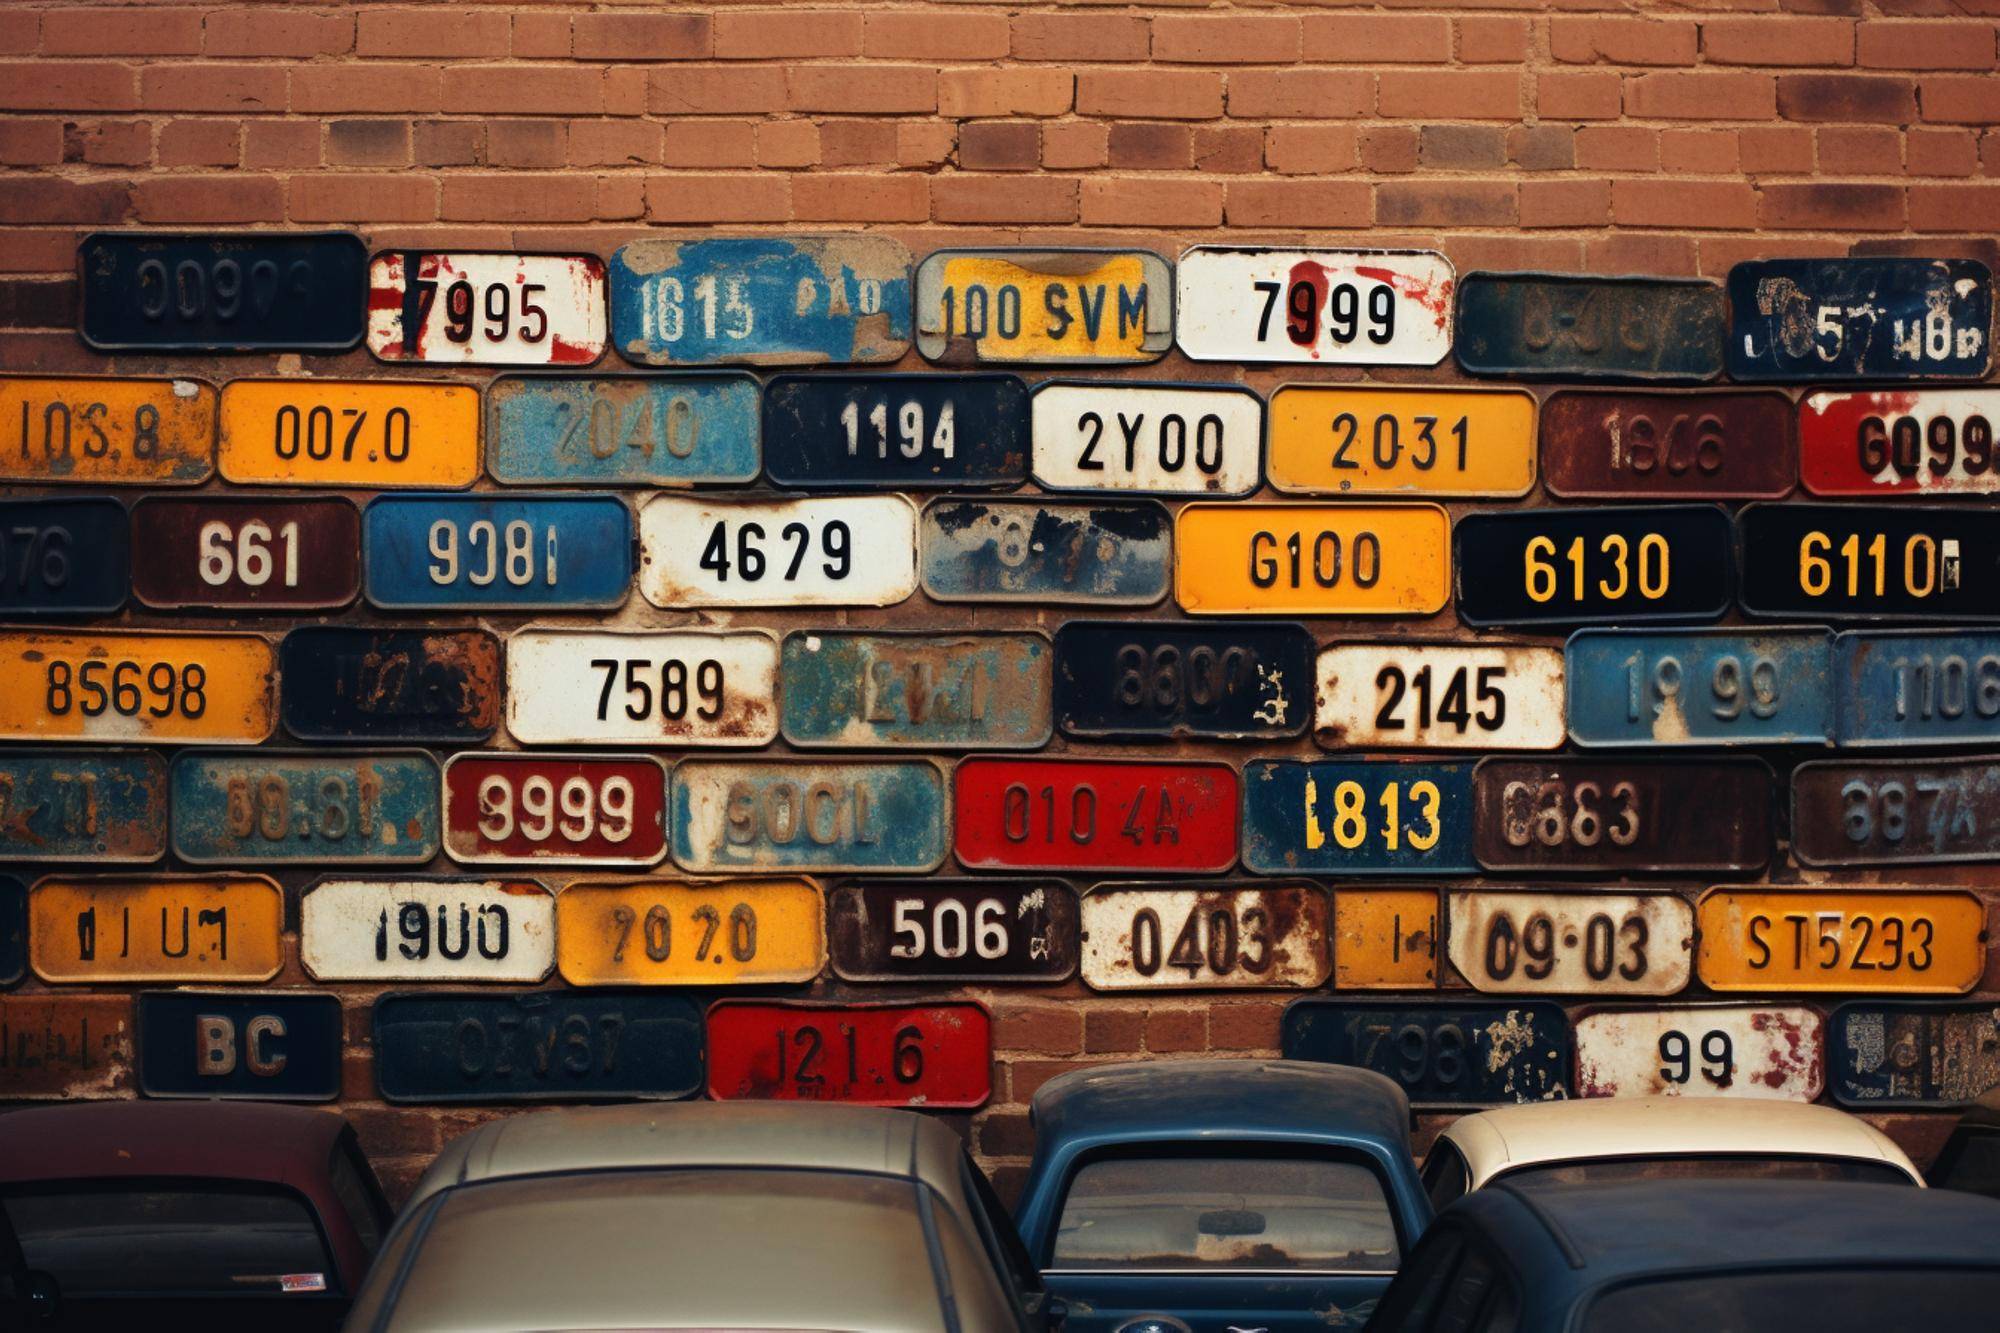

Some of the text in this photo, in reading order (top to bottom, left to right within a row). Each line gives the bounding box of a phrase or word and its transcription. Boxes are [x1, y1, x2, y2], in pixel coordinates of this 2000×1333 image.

[940, 282, 1148, 342] 100 SVM
[1253, 280, 1397, 346] 7999
[840, 400, 956, 459] 1194
[1076, 411, 1225, 474] 2Y00
[1857, 415, 1993, 475] 6099
[200, 520, 299, 587] 661
[1524, 533, 1670, 603] 6130
[46, 660, 207, 719] 85698
[590, 658, 725, 722] 7589
[1375, 665, 1507, 734] 2145
[478, 775, 635, 843] 9999
[198, 1013, 287, 1077] BC
[1658, 1028, 1734, 1087] 99
